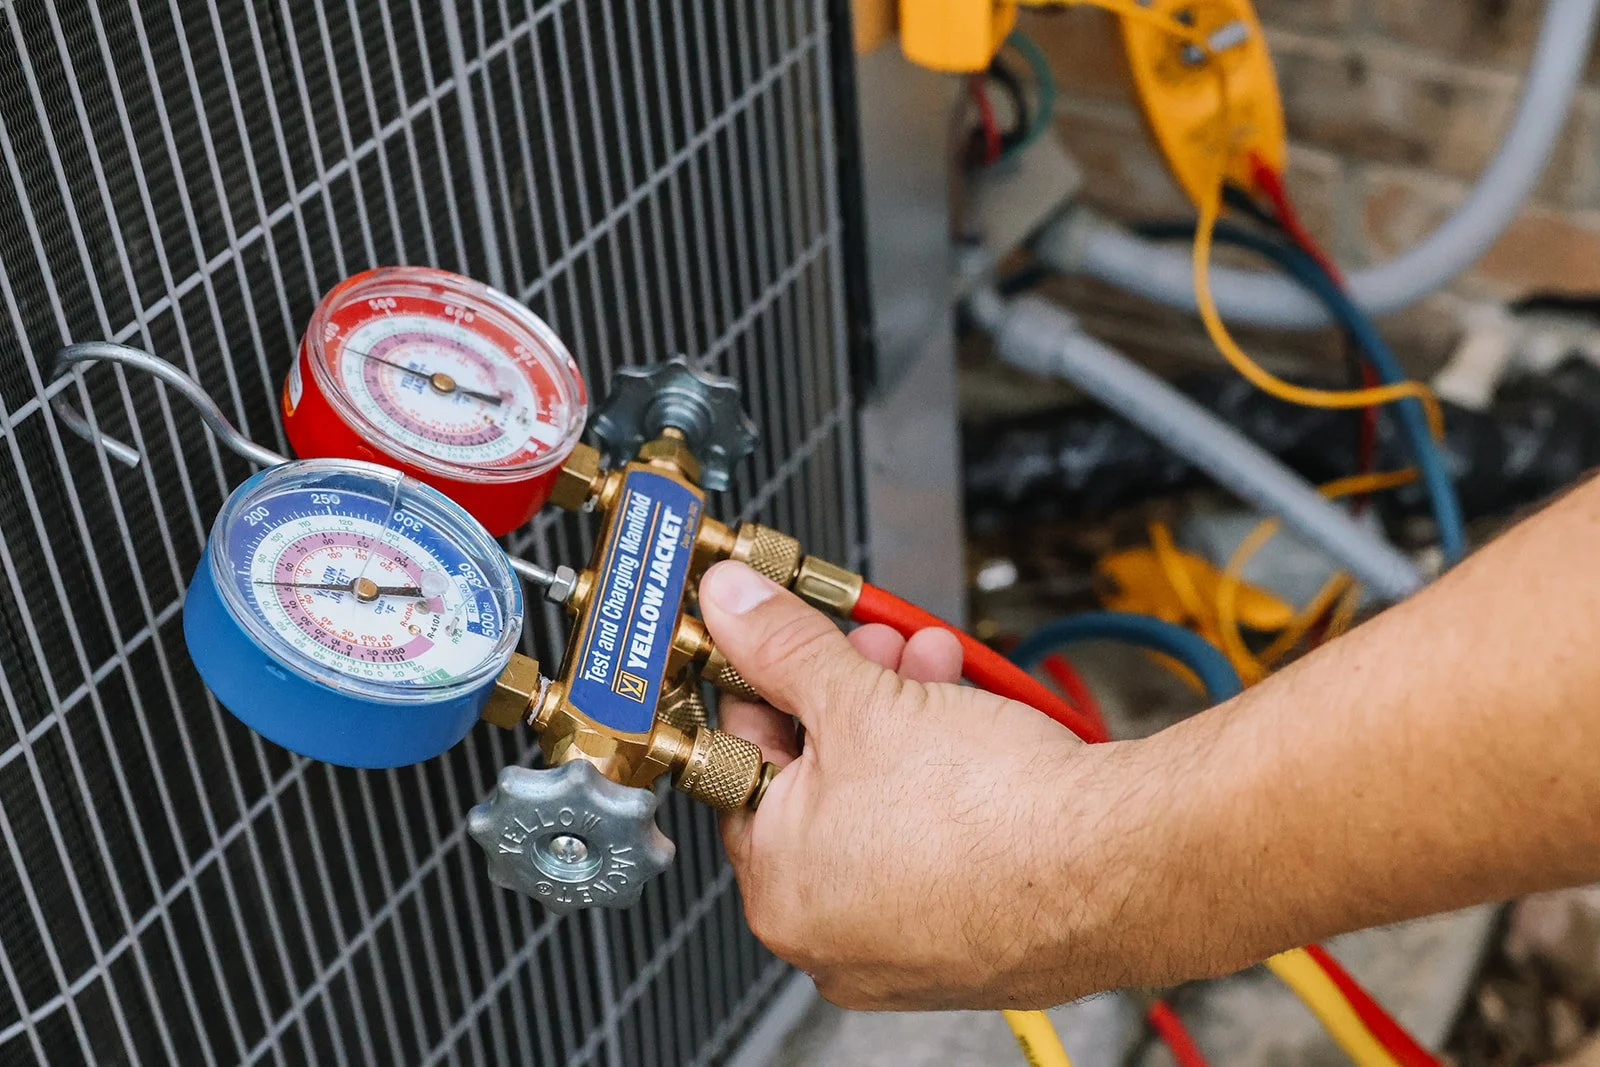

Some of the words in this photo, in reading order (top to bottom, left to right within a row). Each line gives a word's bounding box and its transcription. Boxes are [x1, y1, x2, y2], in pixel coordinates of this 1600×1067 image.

[311, 494, 340, 505] 250
[244, 506, 270, 526] 200
[393, 512, 423, 532] 300
[620, 492, 651, 555] Manifold
[459, 563, 484, 588] 350
[602, 556, 639, 621] Charging
[627, 583, 666, 670] YELLOW
[649, 506, 683, 588] JACKET
[427, 614, 442, 639] R-410A
[481, 613, 496, 636] 500
[598, 618, 620, 652] and
[585, 649, 611, 684] Test
[498, 807, 601, 854] YELLOW
